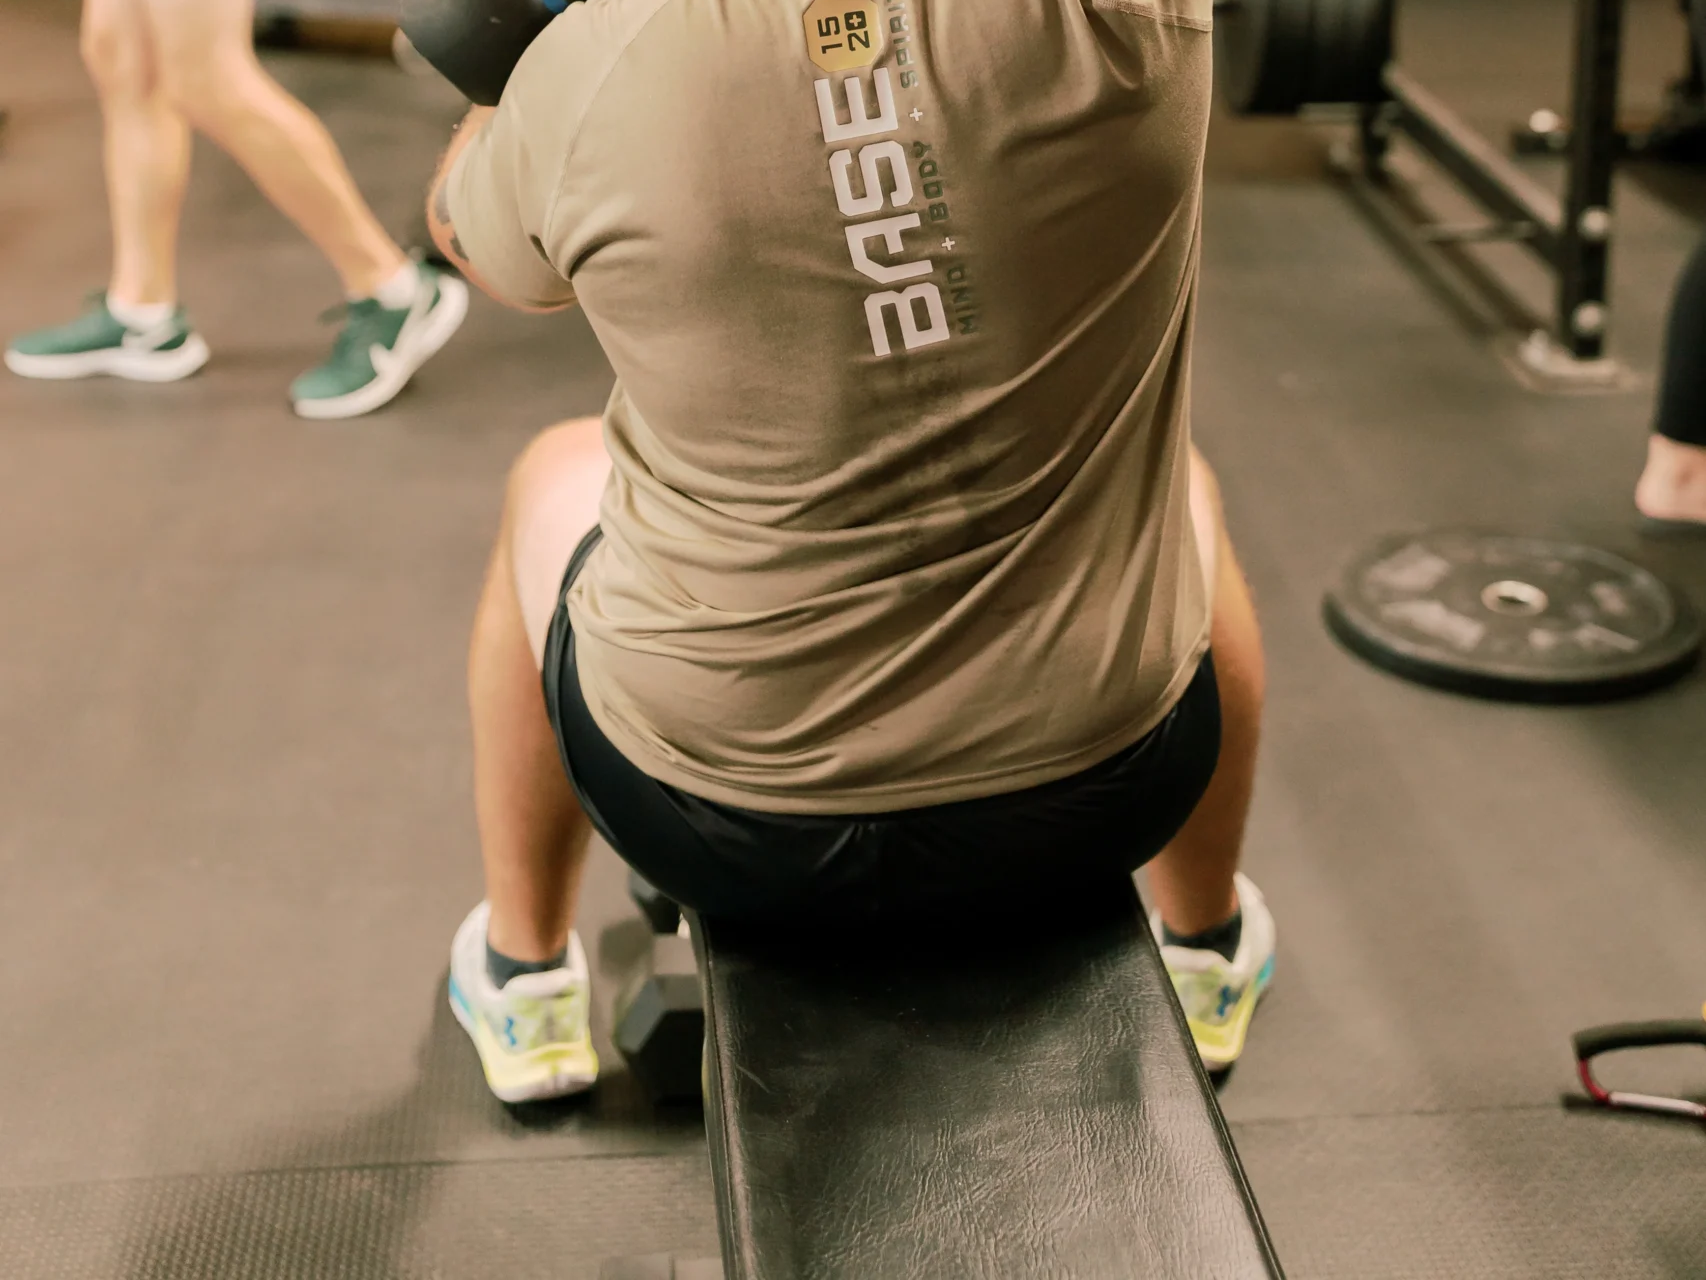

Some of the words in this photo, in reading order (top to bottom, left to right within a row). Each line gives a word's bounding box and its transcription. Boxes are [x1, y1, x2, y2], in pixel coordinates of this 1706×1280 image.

[817, 16, 843, 54] 15
[813, 67, 951, 356] BASE
[912, 140, 949, 222] BODY
[947, 265, 977, 336] MIND
